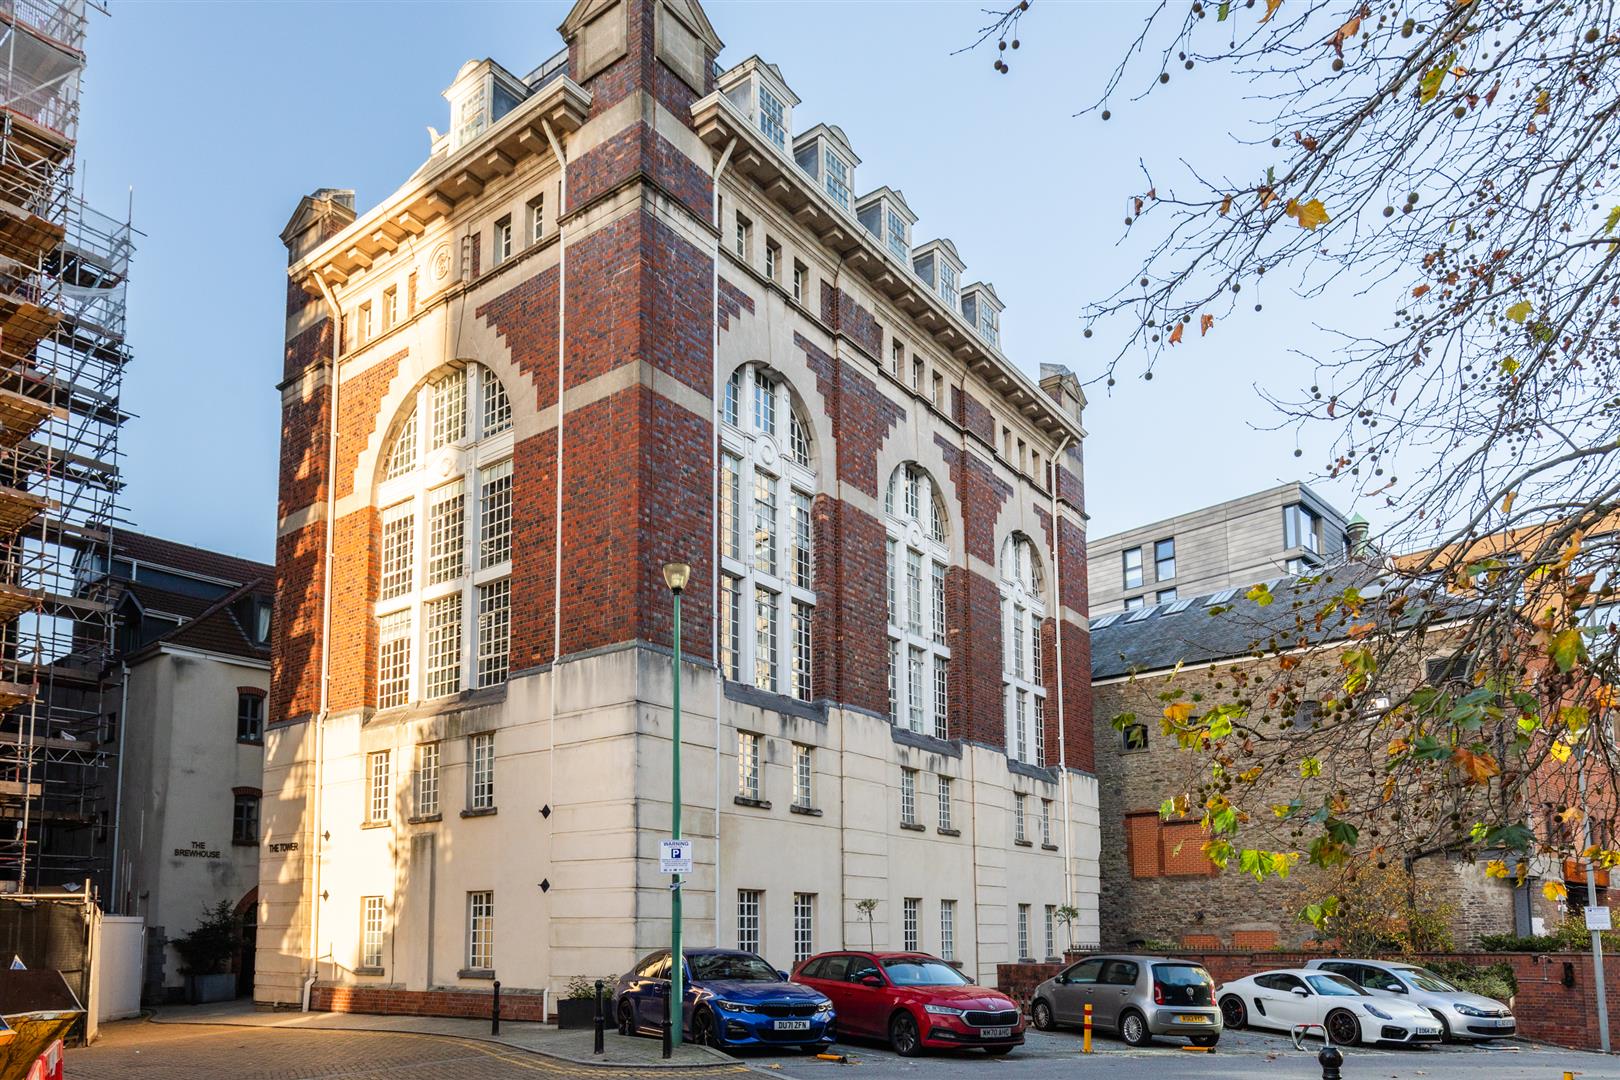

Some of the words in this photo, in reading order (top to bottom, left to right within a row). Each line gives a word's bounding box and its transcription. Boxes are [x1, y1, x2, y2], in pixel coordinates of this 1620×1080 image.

[191, 841, 206, 849] THE
[269, 844, 279, 853] THE
[280, 842, 299, 852] TOWER
[174, 849, 221, 859] BREWHOUSE
[672, 849, 680, 858] P
[778, 1021, 794, 1029] DU71
[794, 1021, 807, 1029] ZFN
